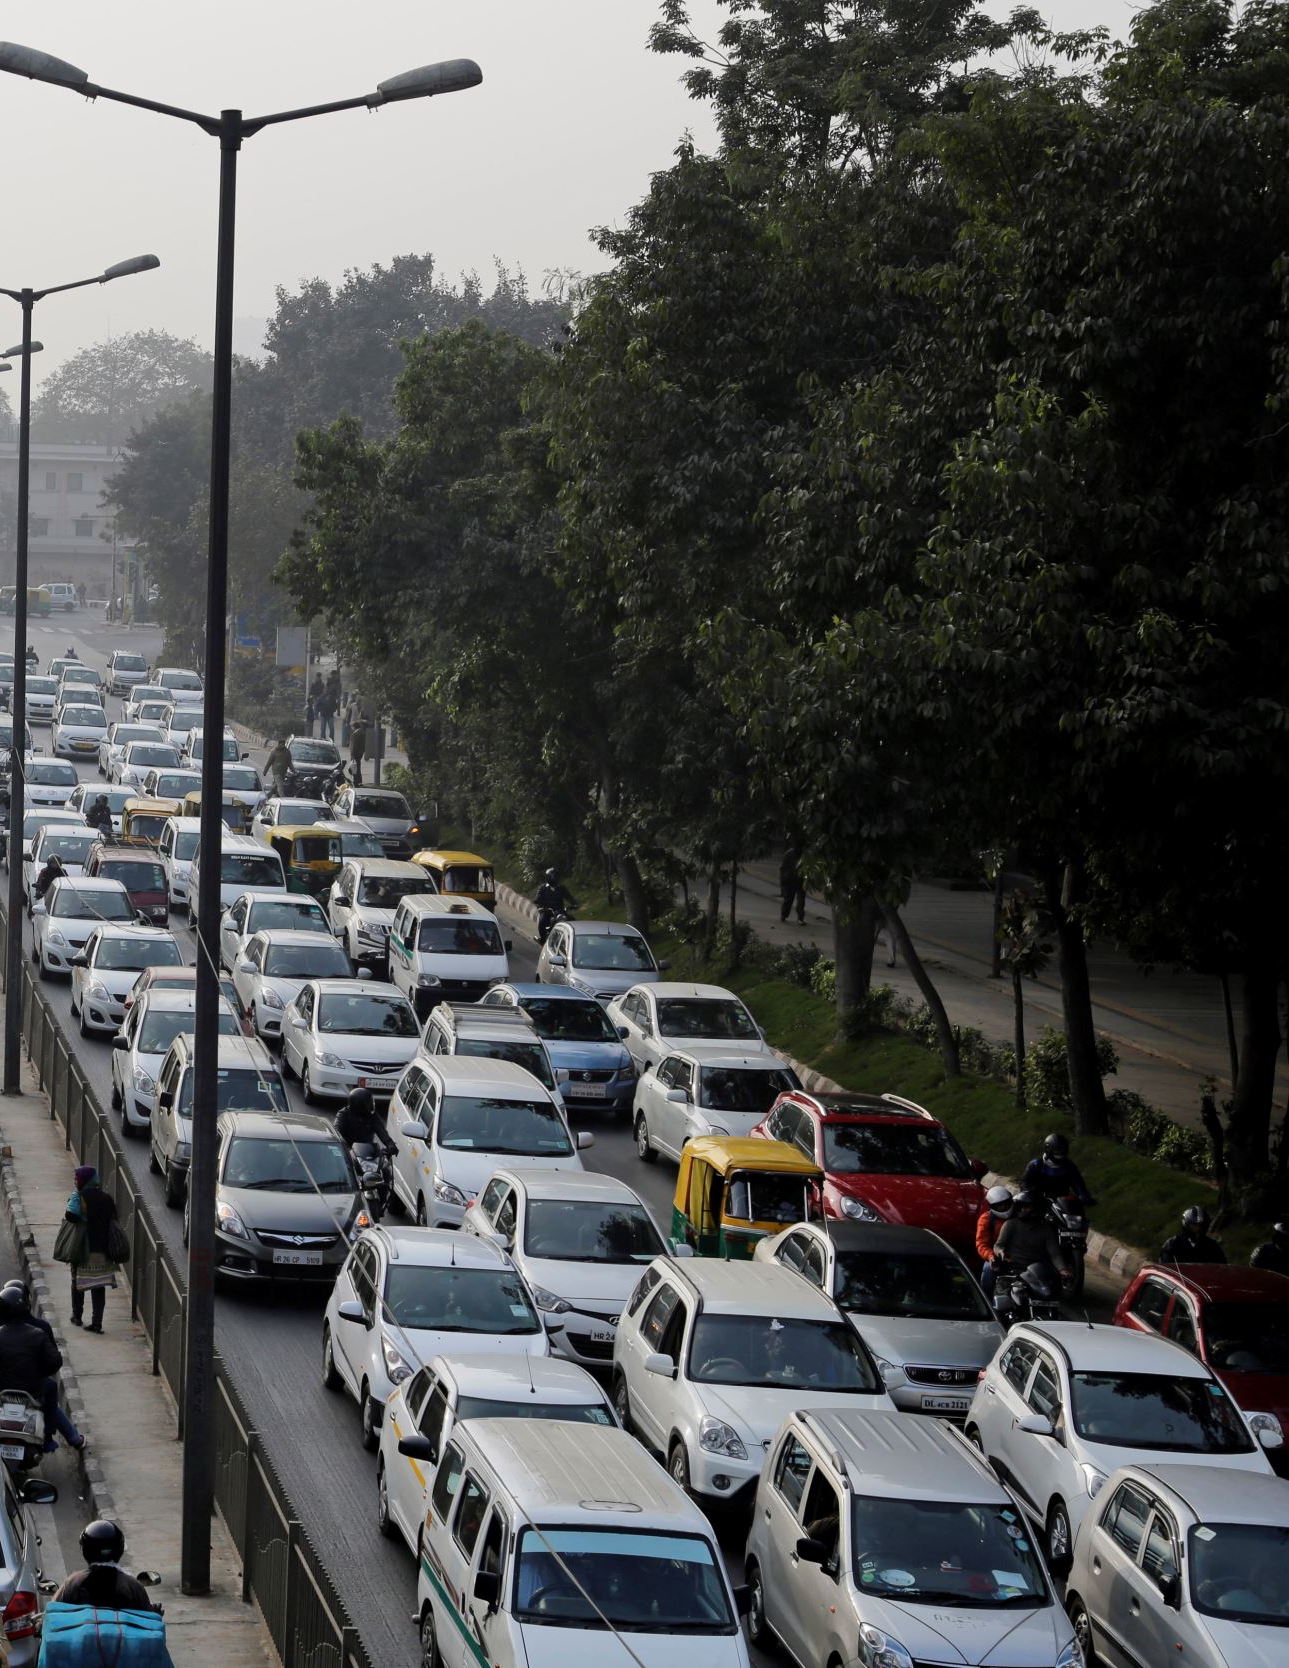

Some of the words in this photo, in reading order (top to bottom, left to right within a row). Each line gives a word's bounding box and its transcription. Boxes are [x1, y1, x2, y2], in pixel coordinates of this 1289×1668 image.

[593, 1332, 604, 1340] HR
[924, 1399, 936, 1407] DL
[951, 1401, 968, 1409] 2121
